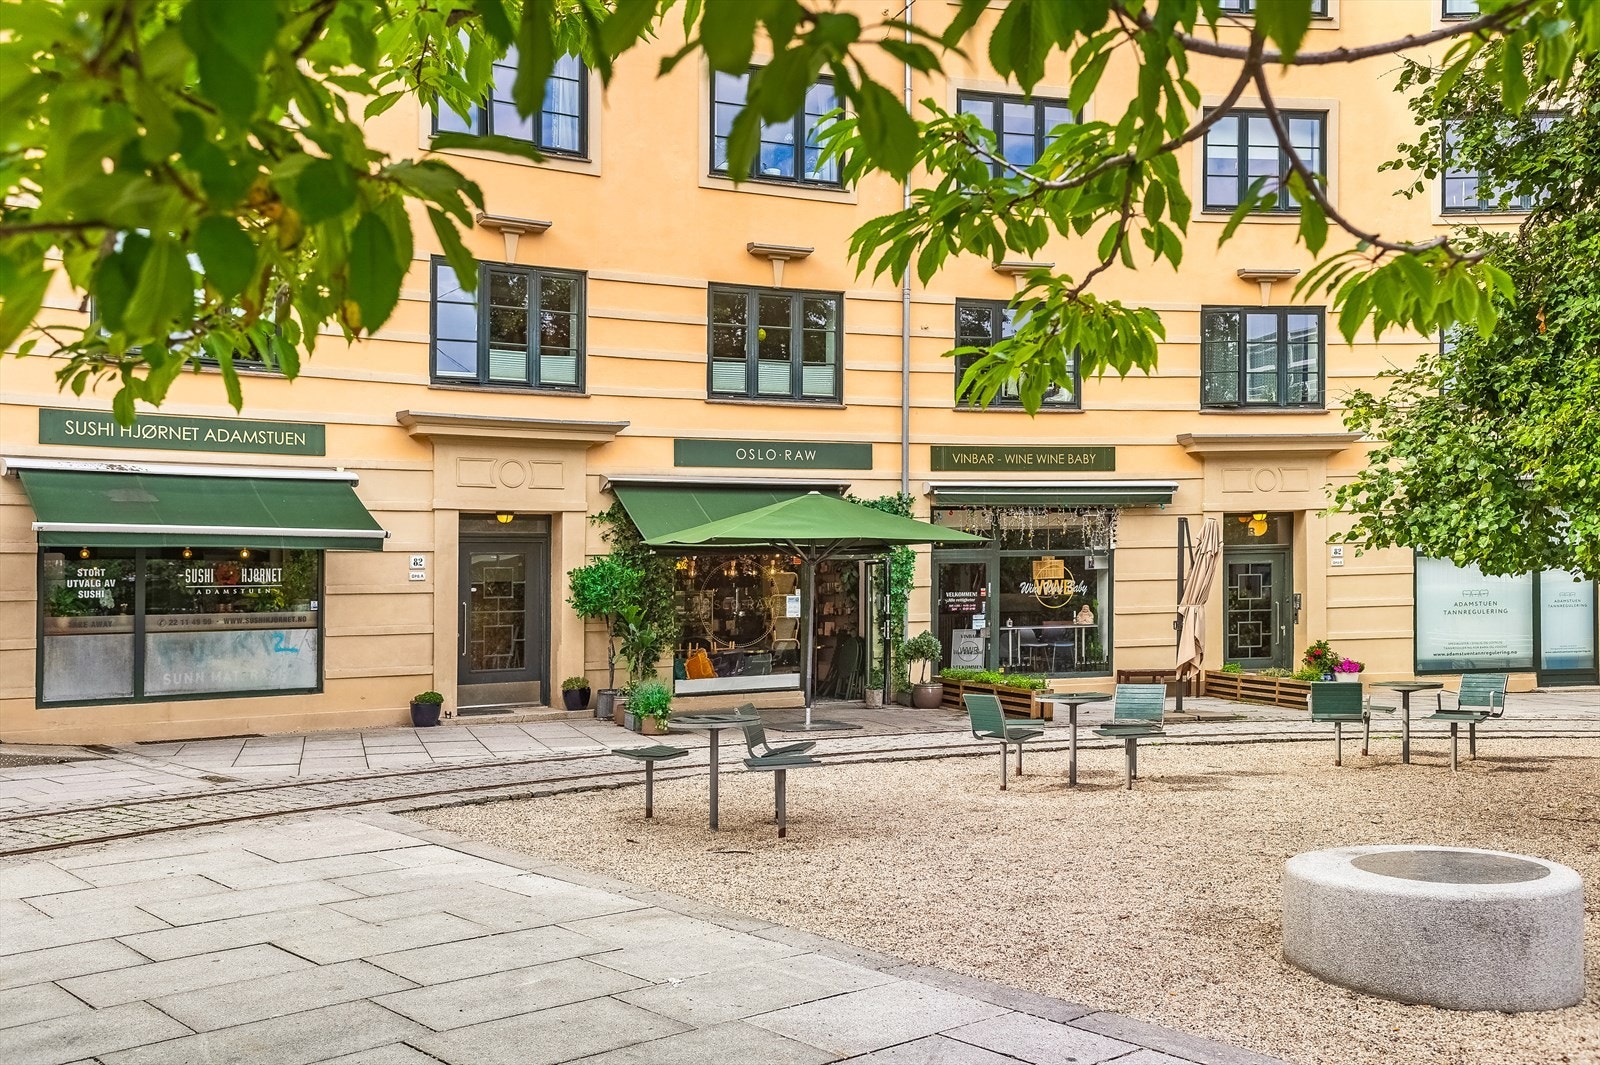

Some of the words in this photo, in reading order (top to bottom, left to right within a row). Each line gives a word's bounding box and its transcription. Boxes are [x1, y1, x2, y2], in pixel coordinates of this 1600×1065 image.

[64, 420, 114, 437] SUSHI
[120, 423, 200, 441] HJØRNET
[203, 428, 306, 446] ADAMSTUEN
[952, 453, 994, 464] VINBAR
[1005, 453, 1033, 464] WINE
[1036, 453, 1065, 464] WINE
[1067, 453, 1096, 464] BABY
[413, 557, 423, 567] 82
[77, 568, 106, 577] STORT
[185, 568, 214, 583] SUSHI
[241, 567, 282, 583] HJØRNET
[66, 579, 101, 588] UTVALG
[104, 579, 116, 588] AV
[78, 590, 105, 599] SUSHI
[1443, 608, 1508, 616] TANNREGULERING
[91, 620, 113, 628] AWAY
[163, 672, 206, 686] SUNN
